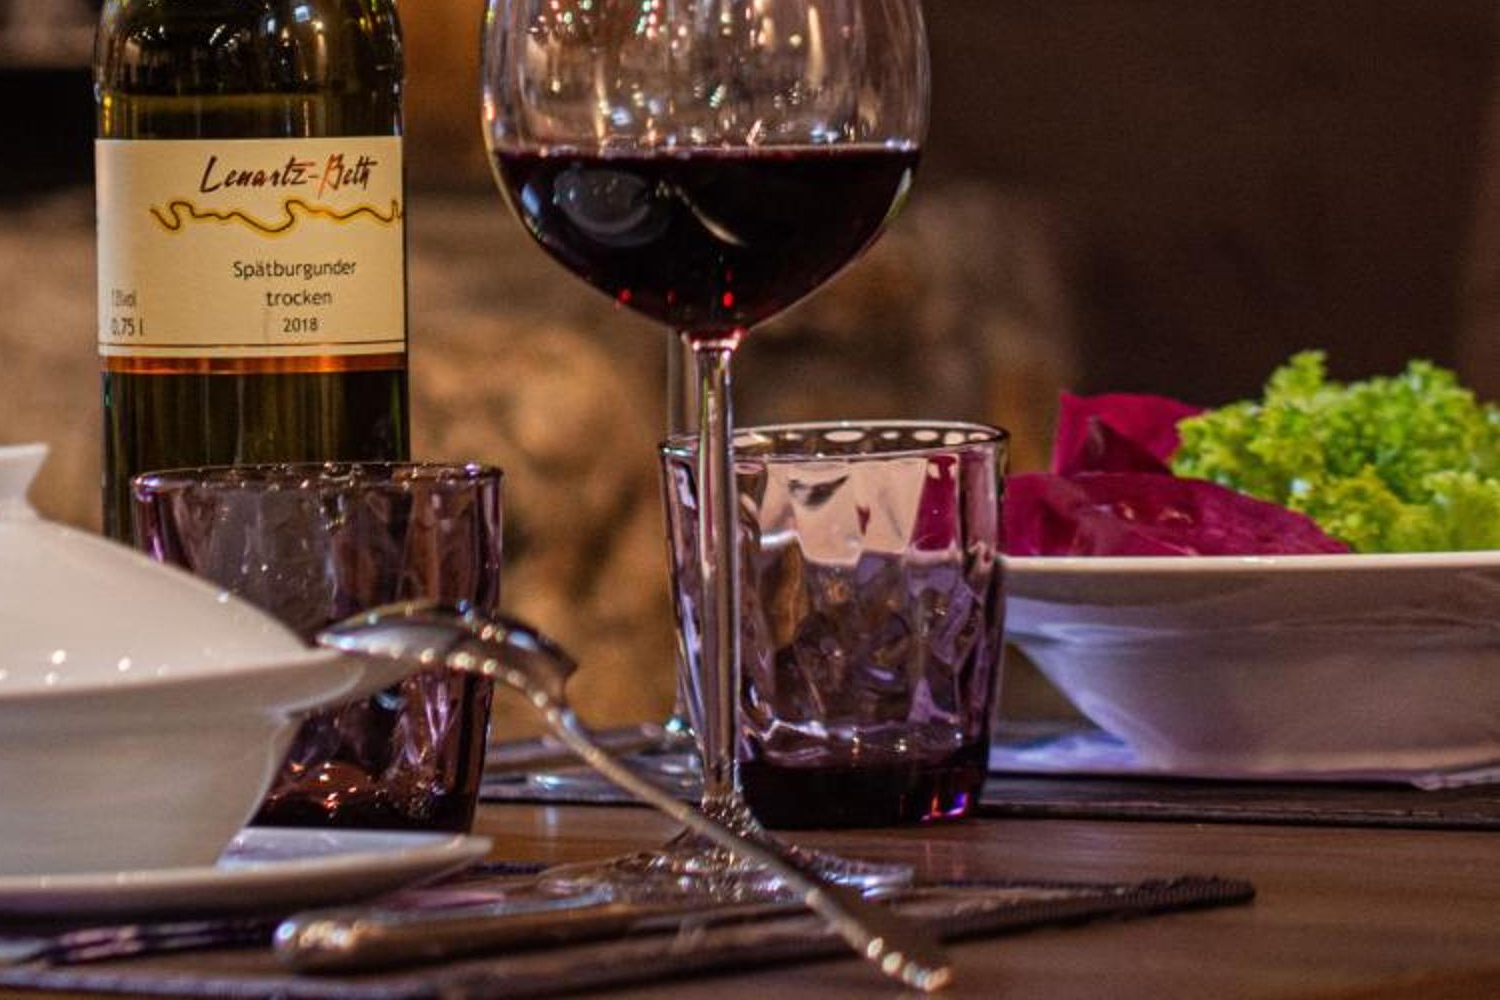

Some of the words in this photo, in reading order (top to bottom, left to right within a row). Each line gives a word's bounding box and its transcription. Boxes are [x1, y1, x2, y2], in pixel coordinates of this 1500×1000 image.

[199, 152, 378, 200] Lenartz-Beth
[232, 258, 356, 280] Spätburgunder
[265, 289, 332, 307] trocken
[282, 317, 318, 333] 2018
